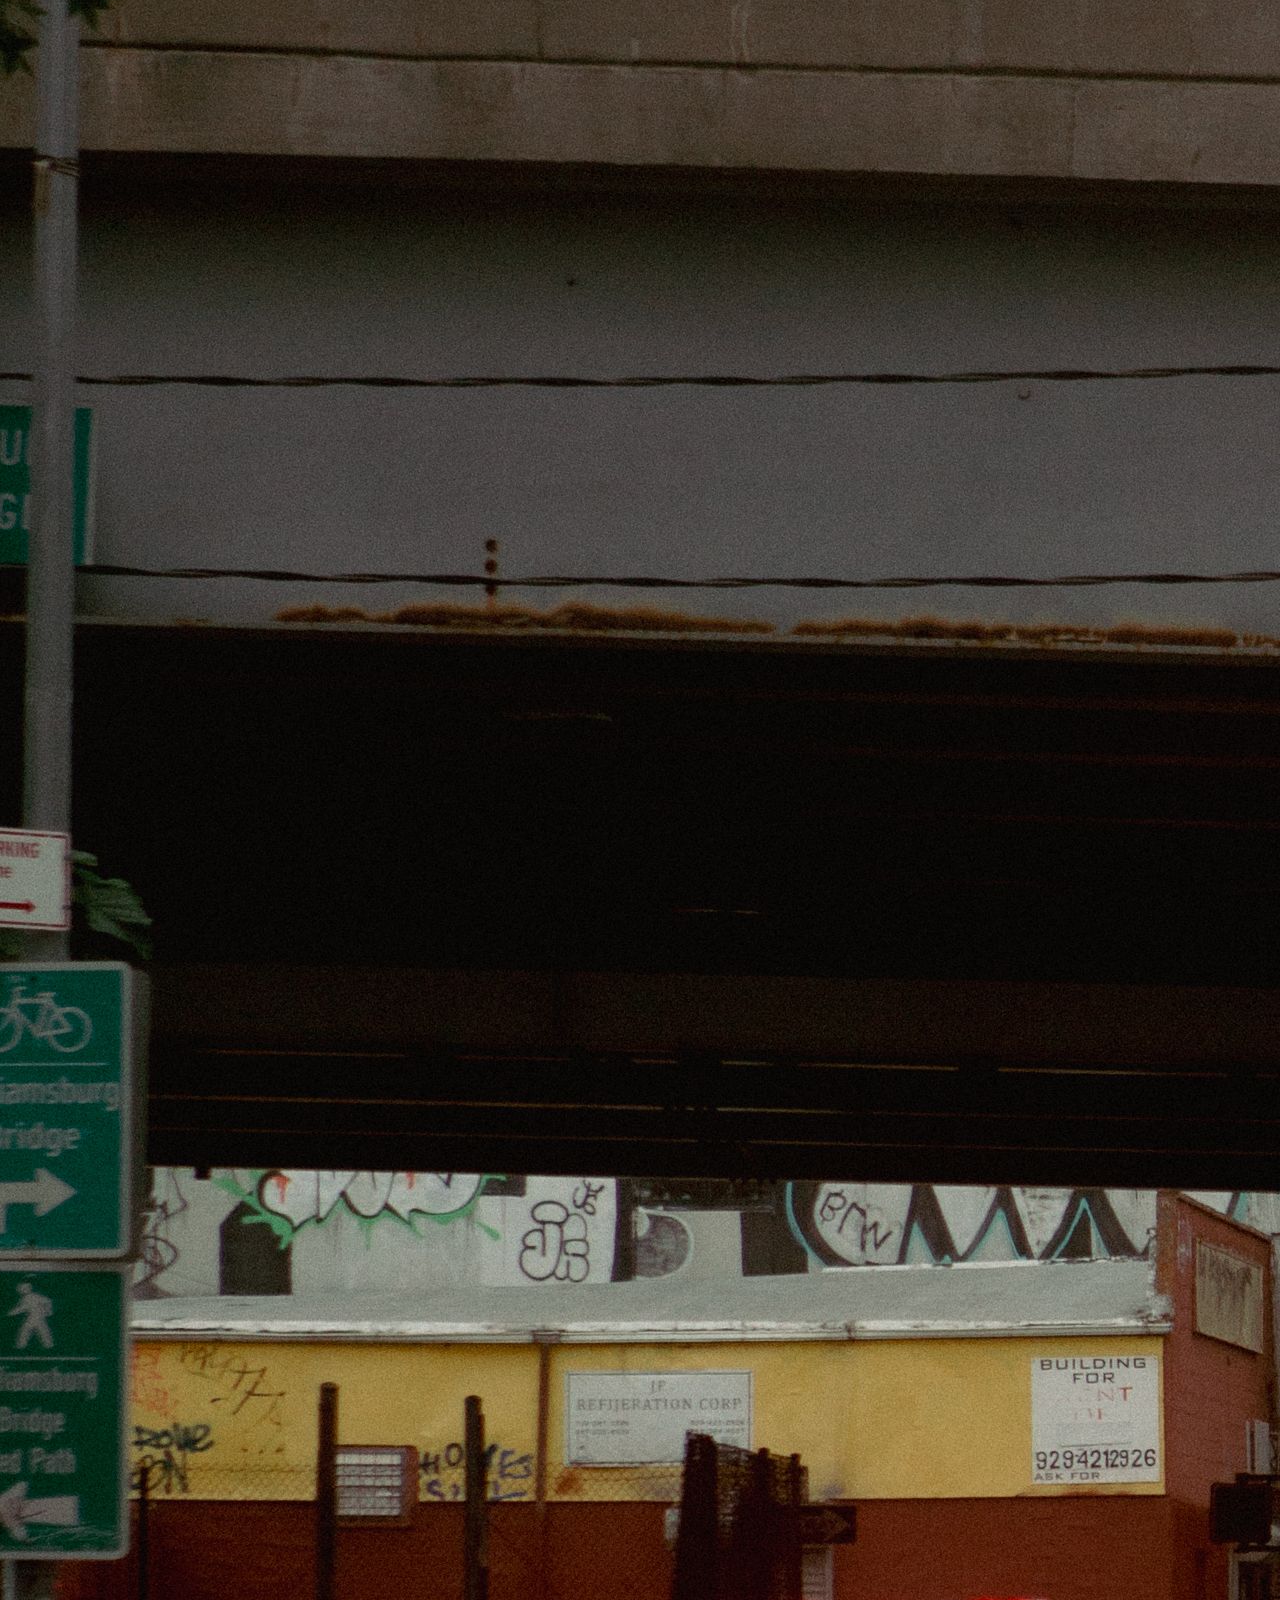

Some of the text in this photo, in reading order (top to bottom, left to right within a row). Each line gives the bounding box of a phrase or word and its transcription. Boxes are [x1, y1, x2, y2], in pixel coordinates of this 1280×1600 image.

[1041, 1358, 1146, 1370] BUILDING
[1073, 1373, 1115, 1383] FOR
[699, 1397, 742, 1410] CORP
[1035, 1471, 1100, 1481] ASK FOR
